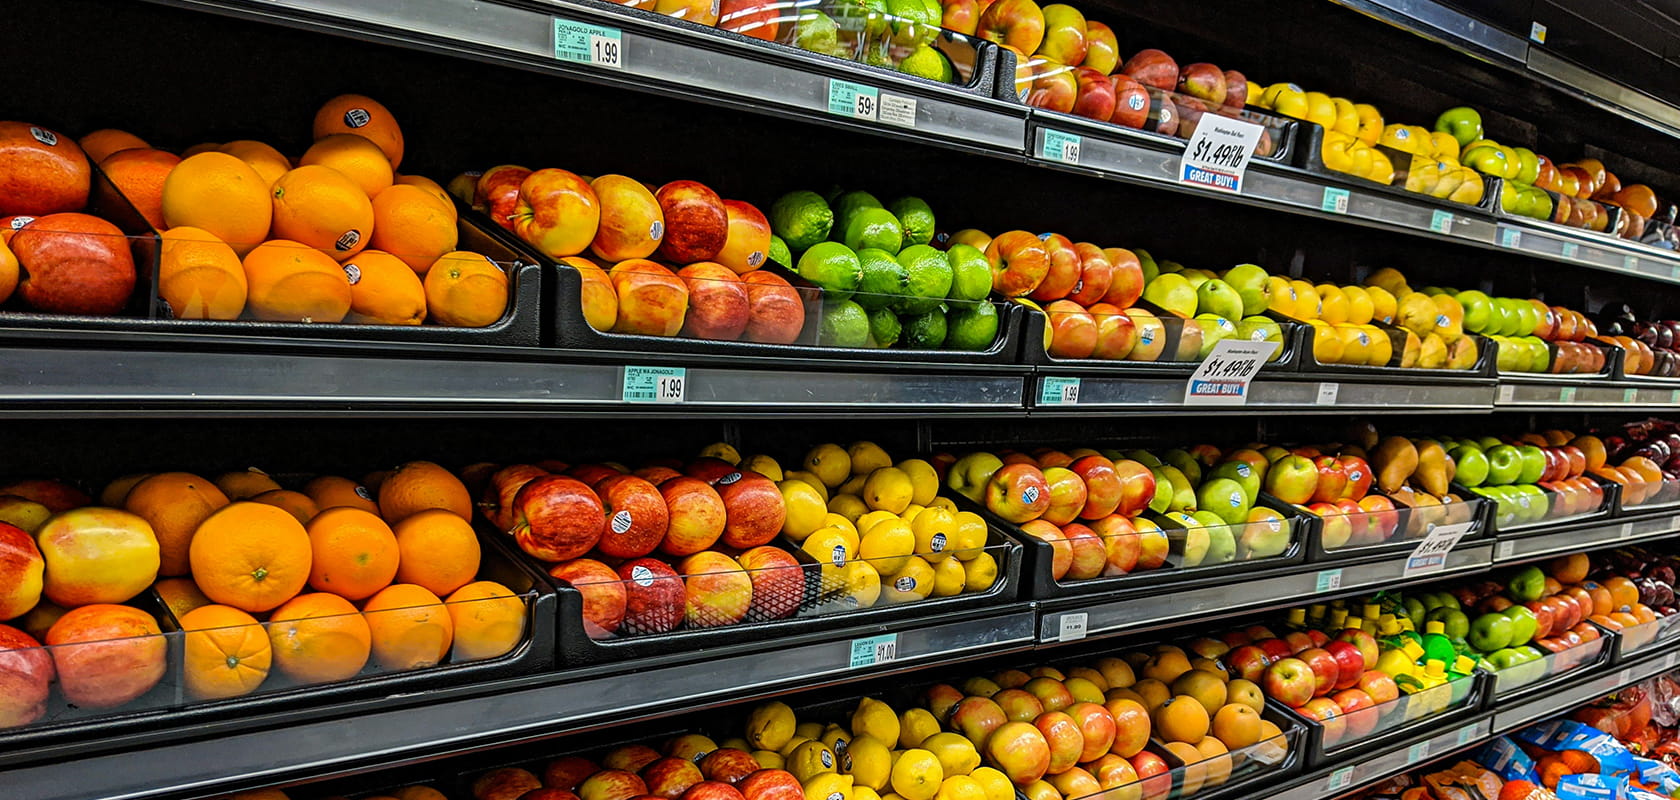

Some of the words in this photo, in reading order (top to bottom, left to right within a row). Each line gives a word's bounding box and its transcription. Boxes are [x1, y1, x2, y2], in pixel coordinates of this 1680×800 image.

[558, 24, 588, 34] JONAGOLD
[589, 28, 606, 37] APPLE
[595, 40, 618, 64] 1.99
[1065, 144, 1078, 161] 1.99
[1190, 169, 1214, 185] GREAT
[1215, 174, 1234, 189] BUY!
[662, 378, 682, 398] 1.99
[1064, 386, 1078, 401] 1.99
[1196, 383, 1221, 393] GREAT
[1221, 383, 1240, 394] BUY!
